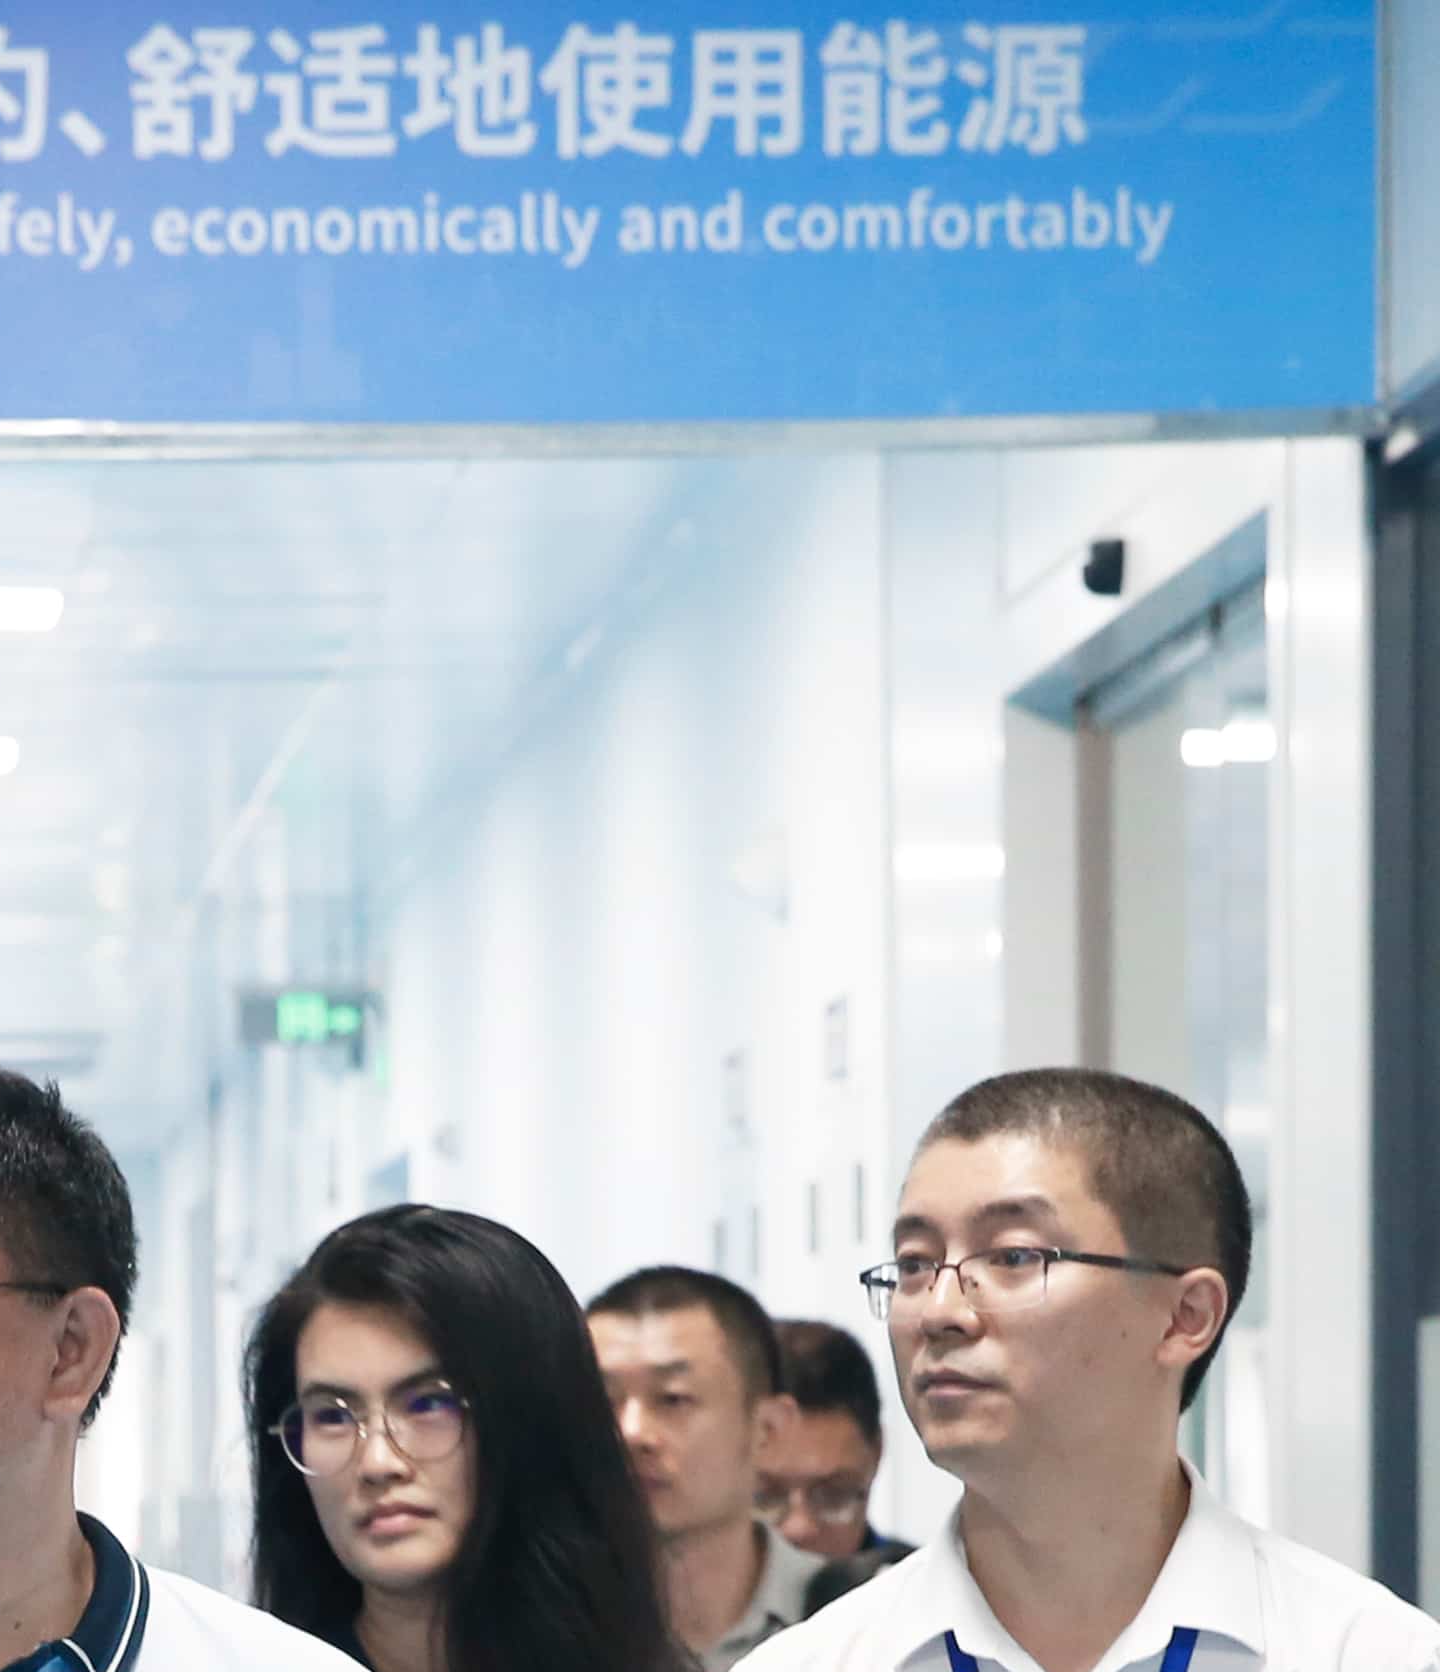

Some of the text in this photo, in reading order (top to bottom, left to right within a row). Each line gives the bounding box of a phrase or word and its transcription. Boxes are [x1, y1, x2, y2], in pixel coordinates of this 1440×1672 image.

[153, 190, 598, 269] economically
[618, 188, 743, 253] and
[764, 185, 1173, 265] comfortably
